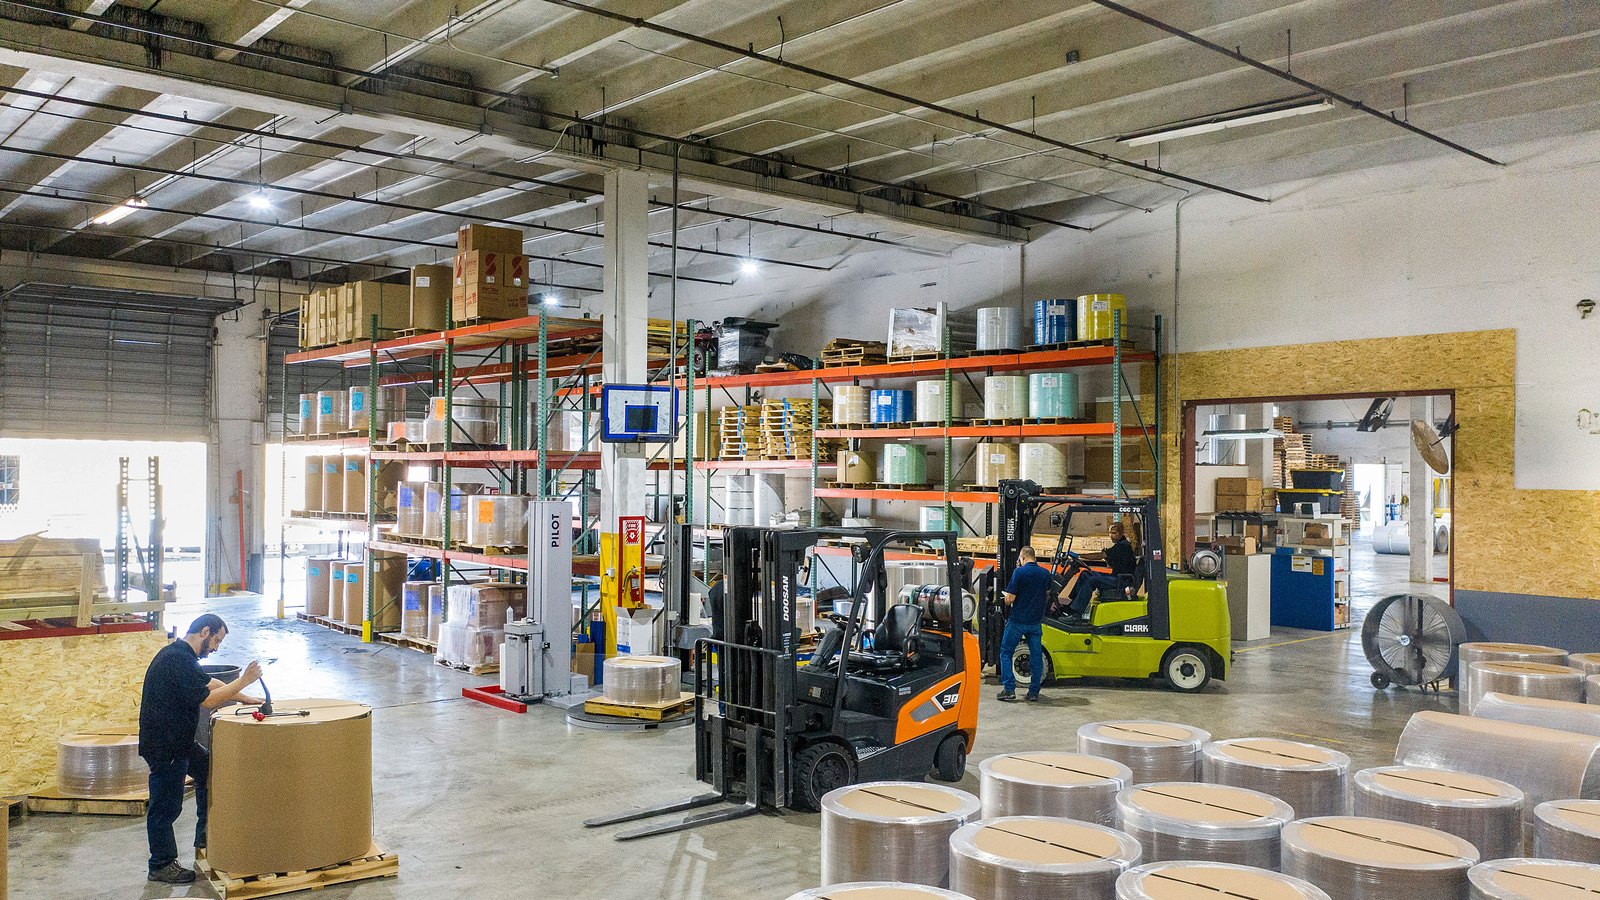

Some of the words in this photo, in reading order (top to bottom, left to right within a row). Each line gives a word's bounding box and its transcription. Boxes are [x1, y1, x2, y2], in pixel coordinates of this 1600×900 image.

[551, 513, 560, 548] PILOT
[1006, 518, 1015, 541] CLARK
[782, 575, 790, 622] DOOSAN
[1123, 624, 1149, 633] CLARK
[942, 693, 960, 705] 30
